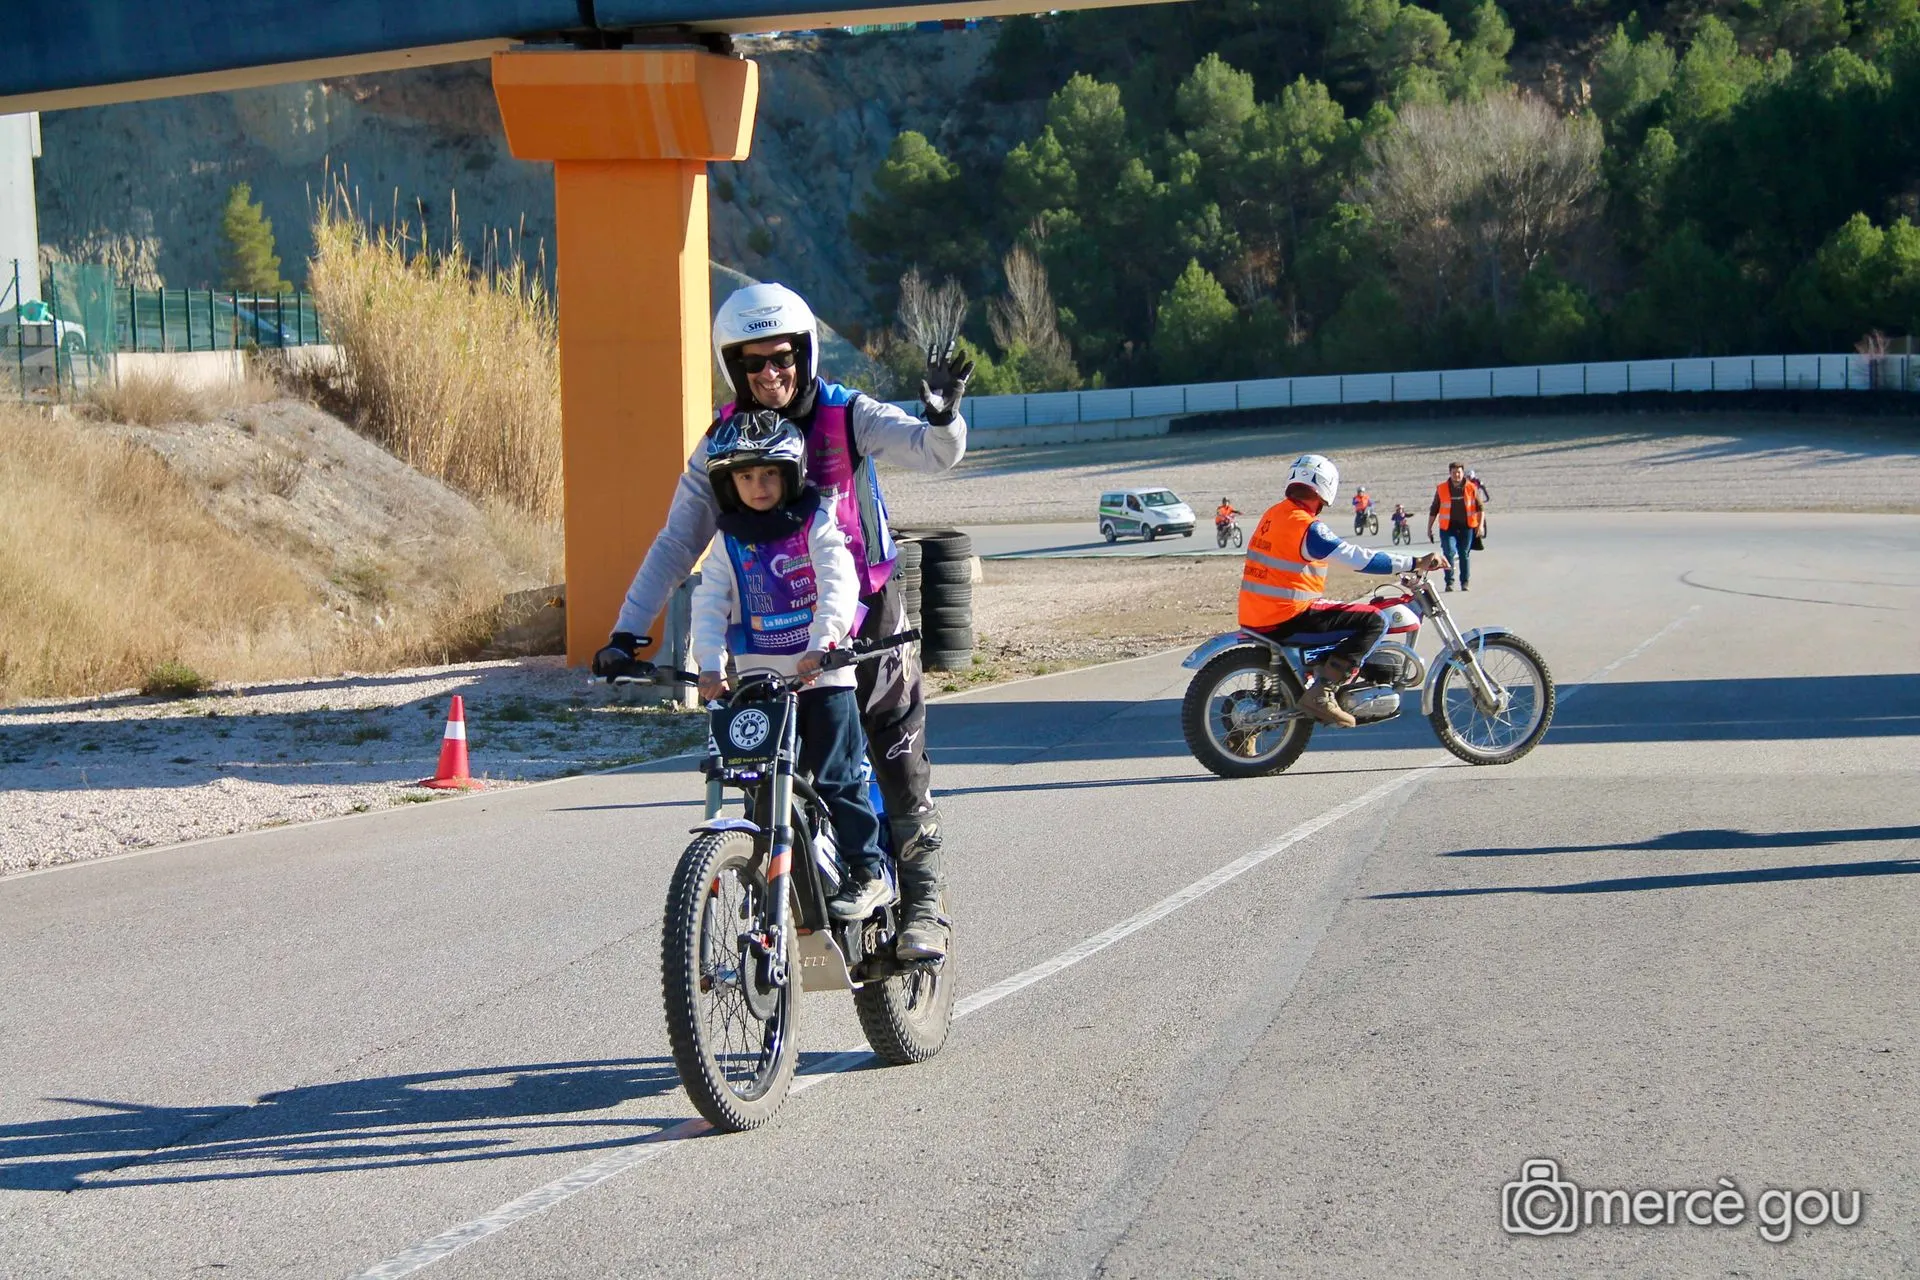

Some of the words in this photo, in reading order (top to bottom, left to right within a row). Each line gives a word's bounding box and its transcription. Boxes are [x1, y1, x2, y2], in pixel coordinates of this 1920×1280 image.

[748, 320, 777, 331] SHOEI
[790, 576, 810, 589] fcm
[790, 593, 817, 608] TrialG
[763, 619, 774, 627] La
[735, 713, 765, 728] SEMPRE
